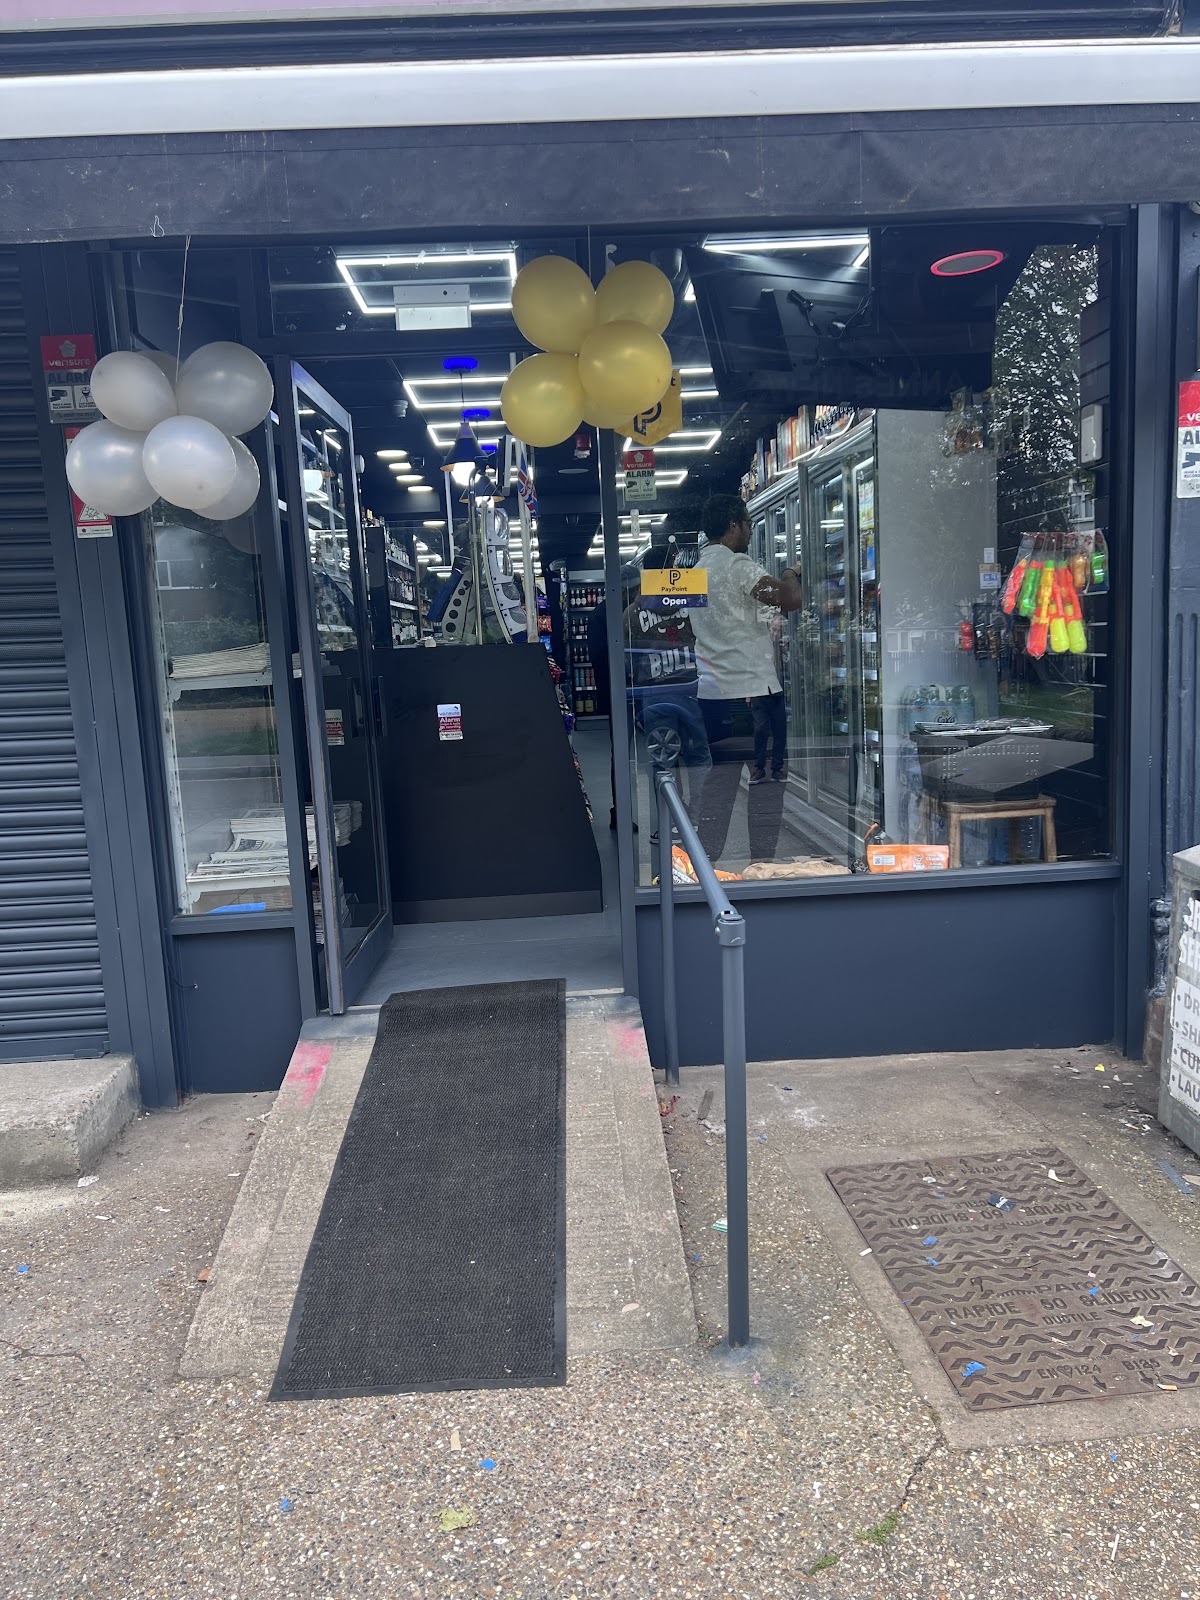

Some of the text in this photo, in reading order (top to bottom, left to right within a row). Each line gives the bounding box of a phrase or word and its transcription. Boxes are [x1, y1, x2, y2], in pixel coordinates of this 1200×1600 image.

[48, 358, 91, 367] verisure
[626, 470, 655, 478] ALARM
[662, 597, 687, 606] Open
[1025, 1202, 1088, 1217] RAPIDE
[980, 1210, 1003, 1220] 50
[944, 1287, 1172, 1321] RAPIDE 50 SLIDEOUT
[1043, 1312, 1102, 1325] DUCTILE
[1074, 1364, 1102, 1375] 124
